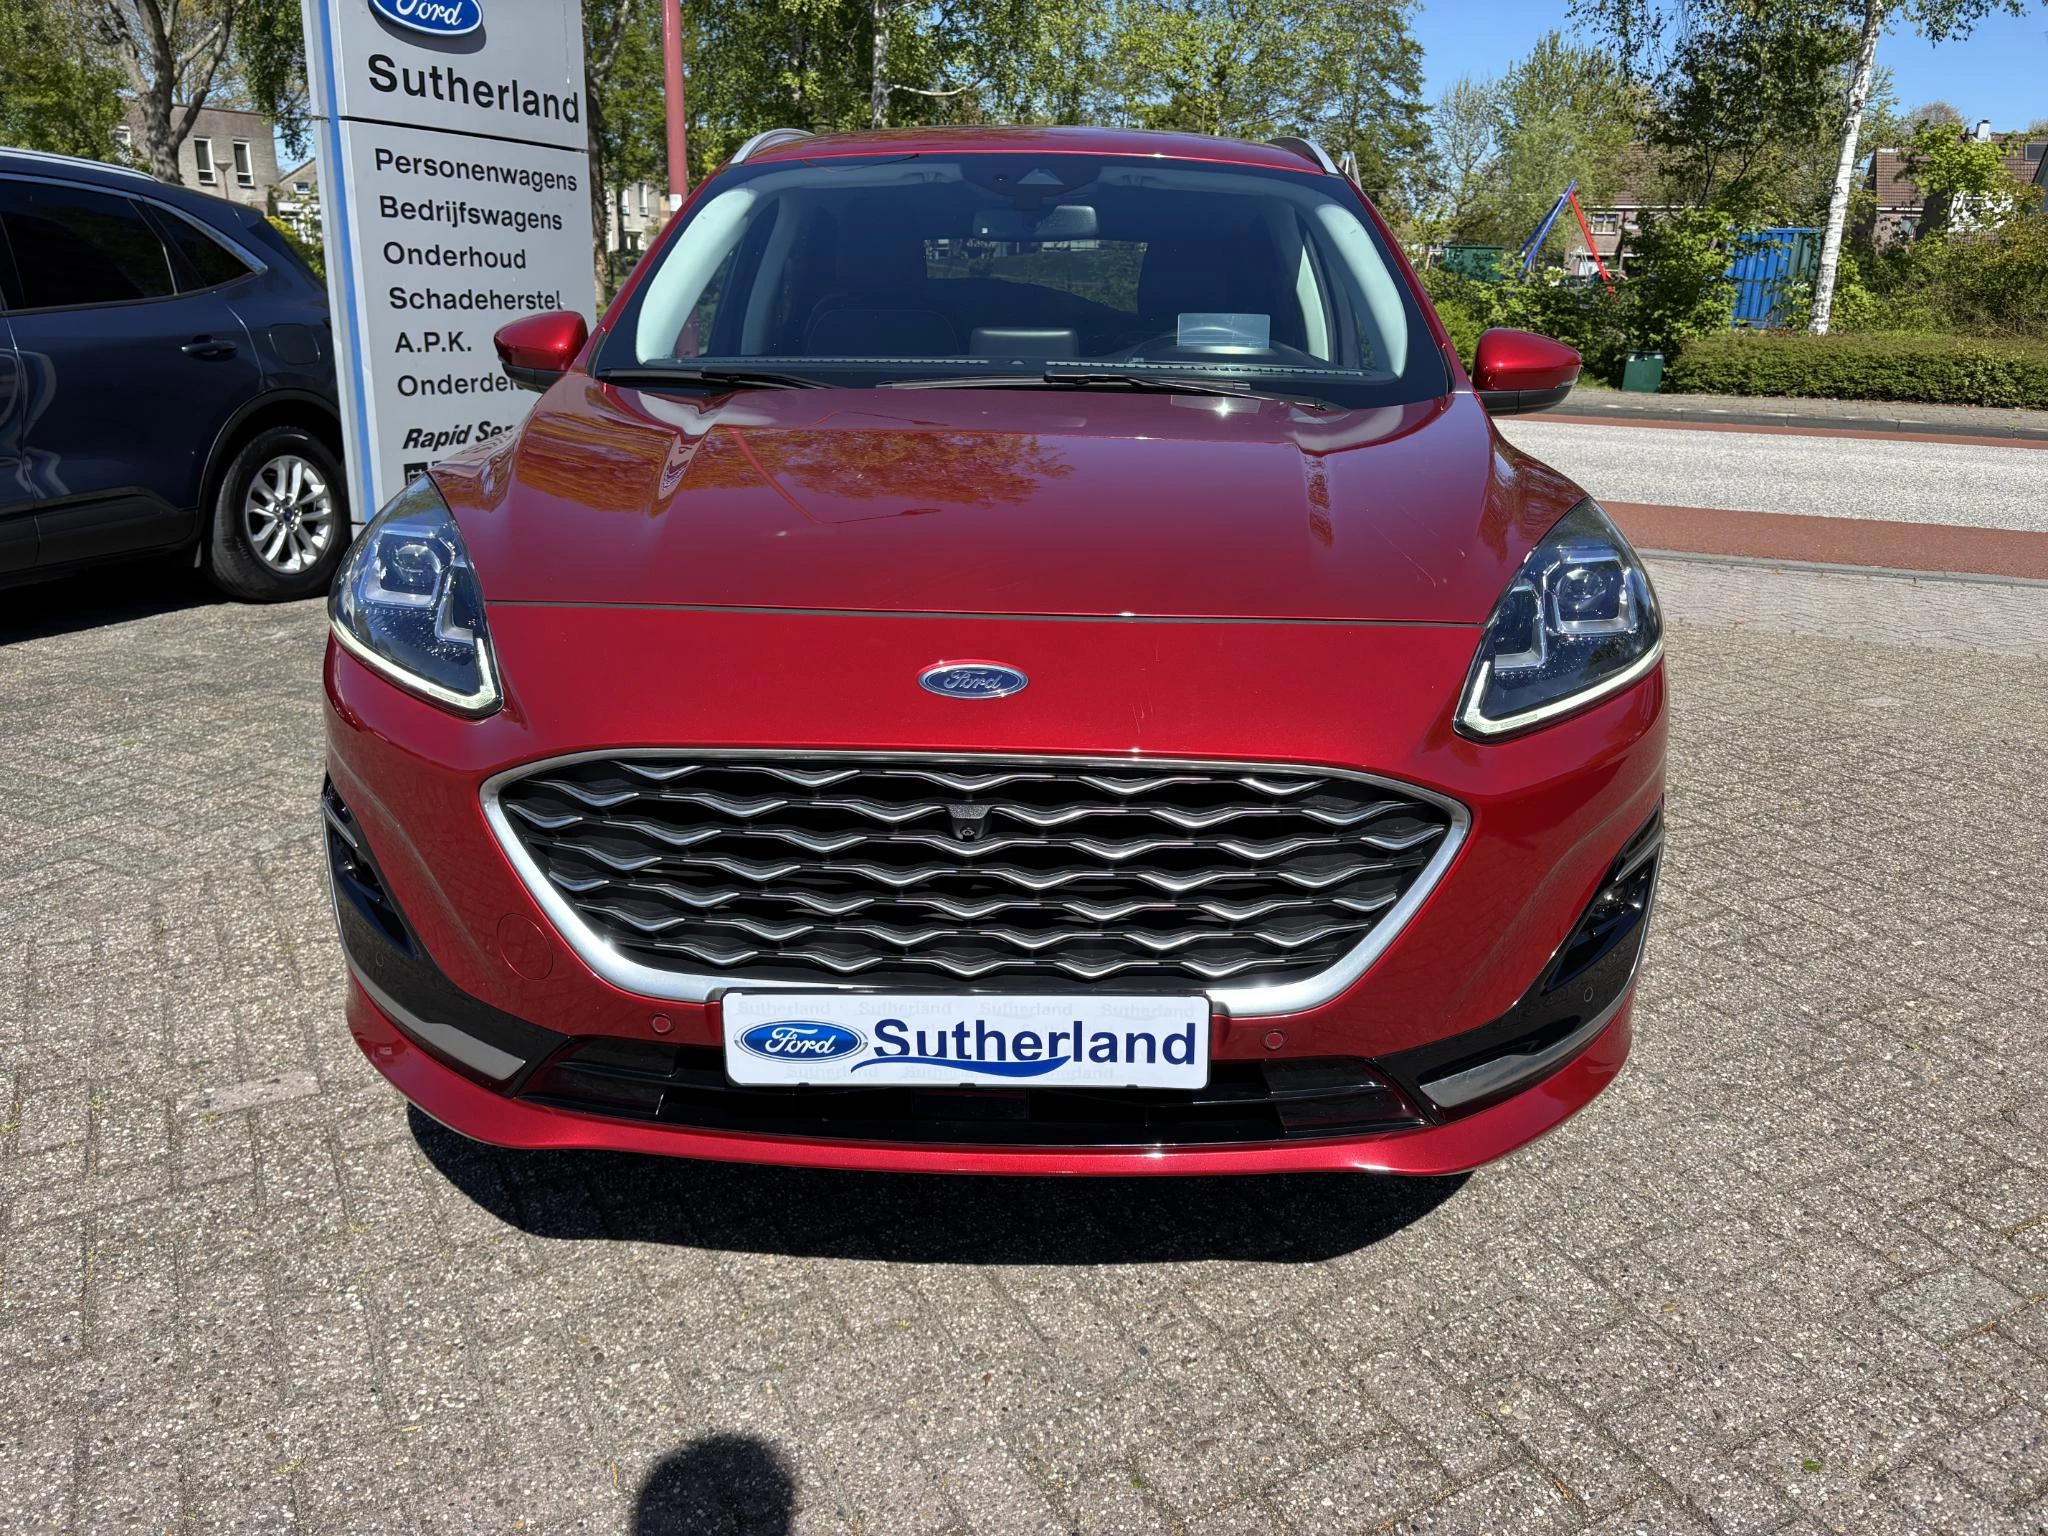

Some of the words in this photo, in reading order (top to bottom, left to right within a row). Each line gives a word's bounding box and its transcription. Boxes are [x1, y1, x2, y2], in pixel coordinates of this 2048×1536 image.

[368, 54, 579, 123] Sutherland
[375, 148, 578, 192] Personenwagens
[379, 195, 563, 232] Bedrijfswagens
[383, 241, 527, 269] Onderhoud
[389, 286, 562, 310] Schadeherstel
[395, 331, 472, 353] A.P.K.
[402, 424, 472, 452] Rapid
[943, 669, 1003, 689] Ford
[765, 1027, 835, 1053] Ford
[873, 1018, 1196, 1066] Sutherland
